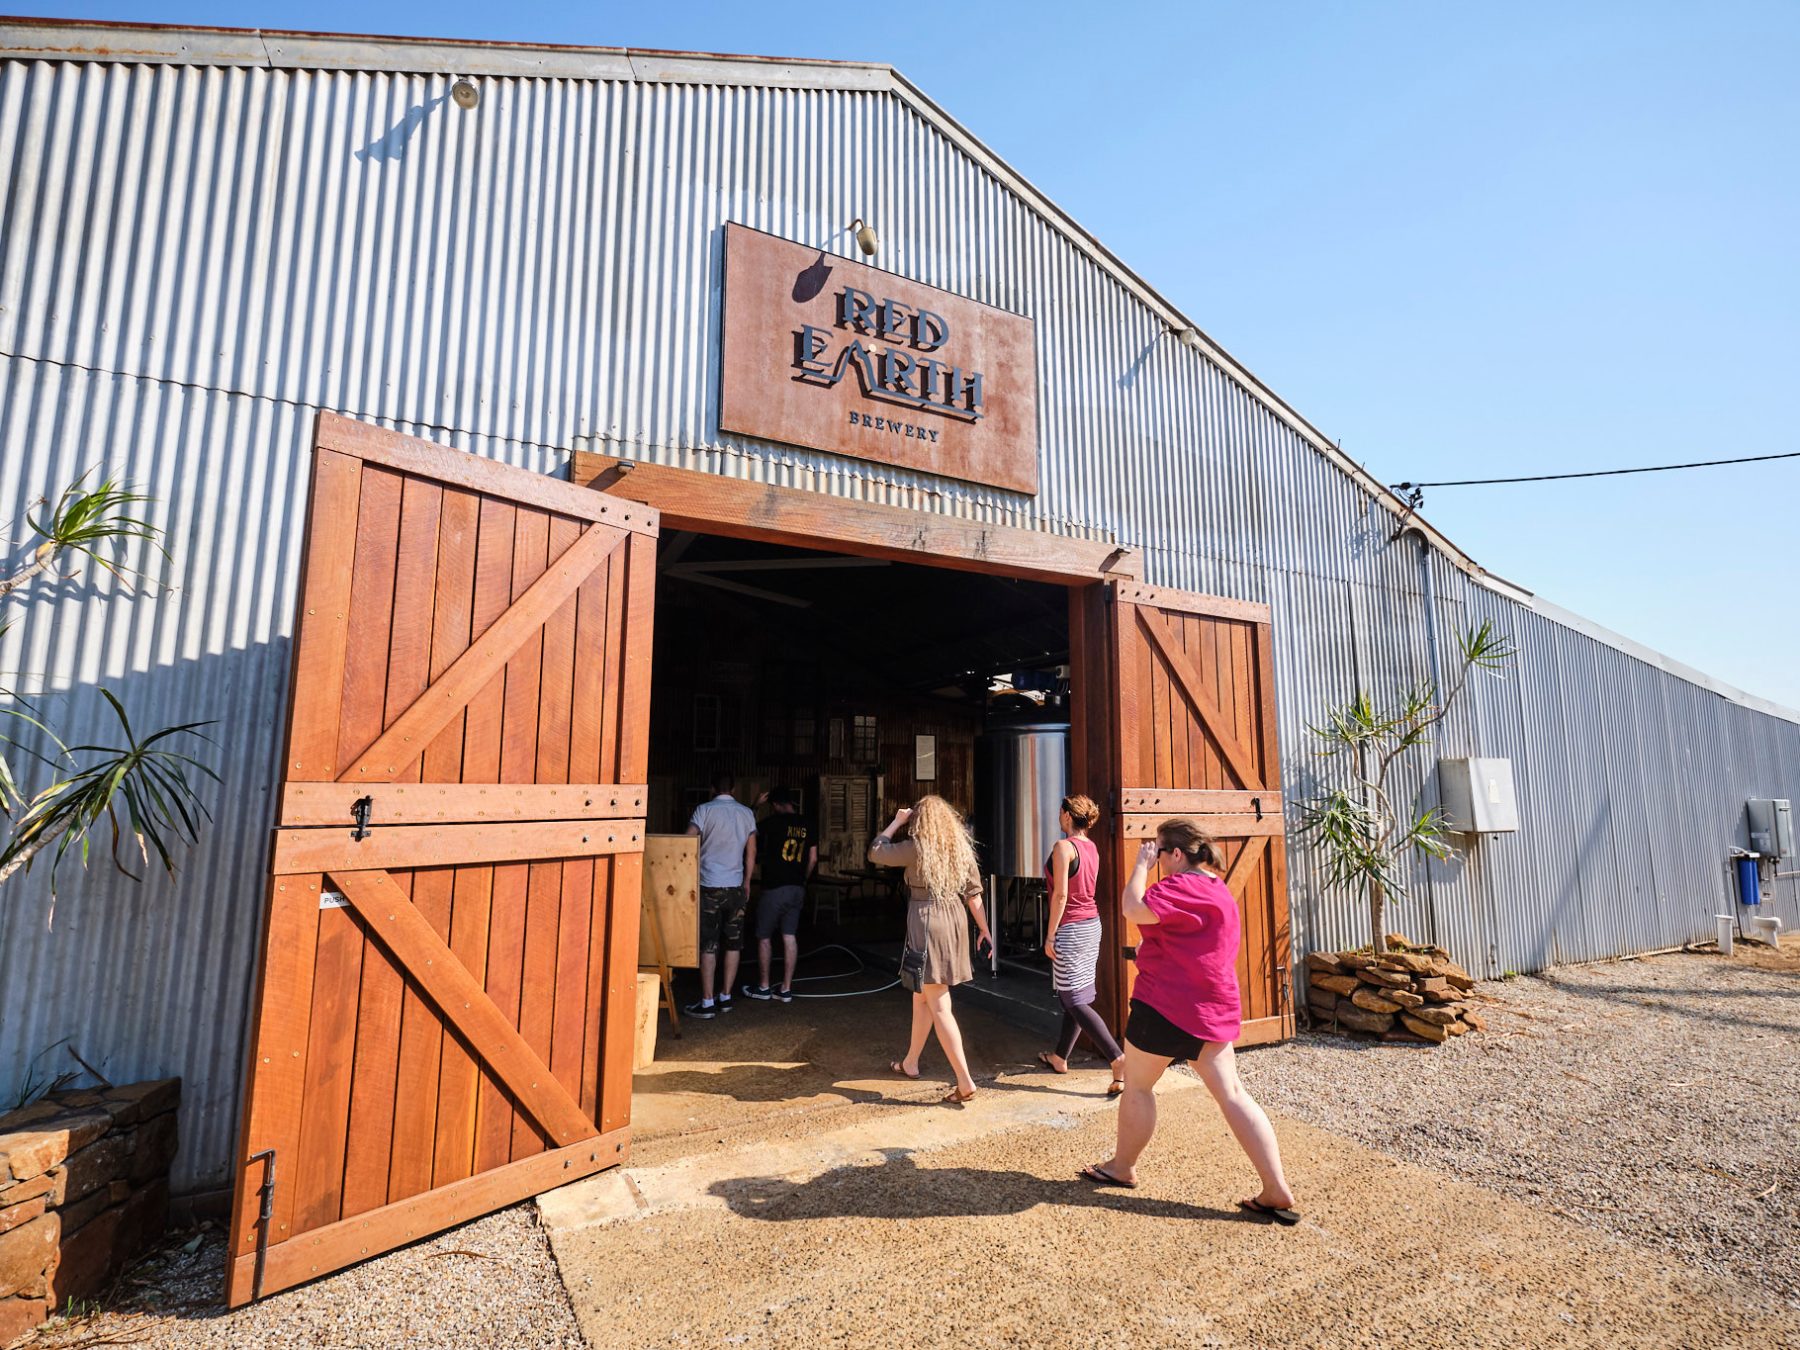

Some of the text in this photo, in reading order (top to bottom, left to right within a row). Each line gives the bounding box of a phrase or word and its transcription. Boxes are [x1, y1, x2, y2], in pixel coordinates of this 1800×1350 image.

[840, 286, 949, 349] RED
[797, 324, 985, 411] EARTH
[849, 411, 939, 442] BREWERY
[782, 839, 806, 862] 01
[323, 896, 345, 904] PUSH
